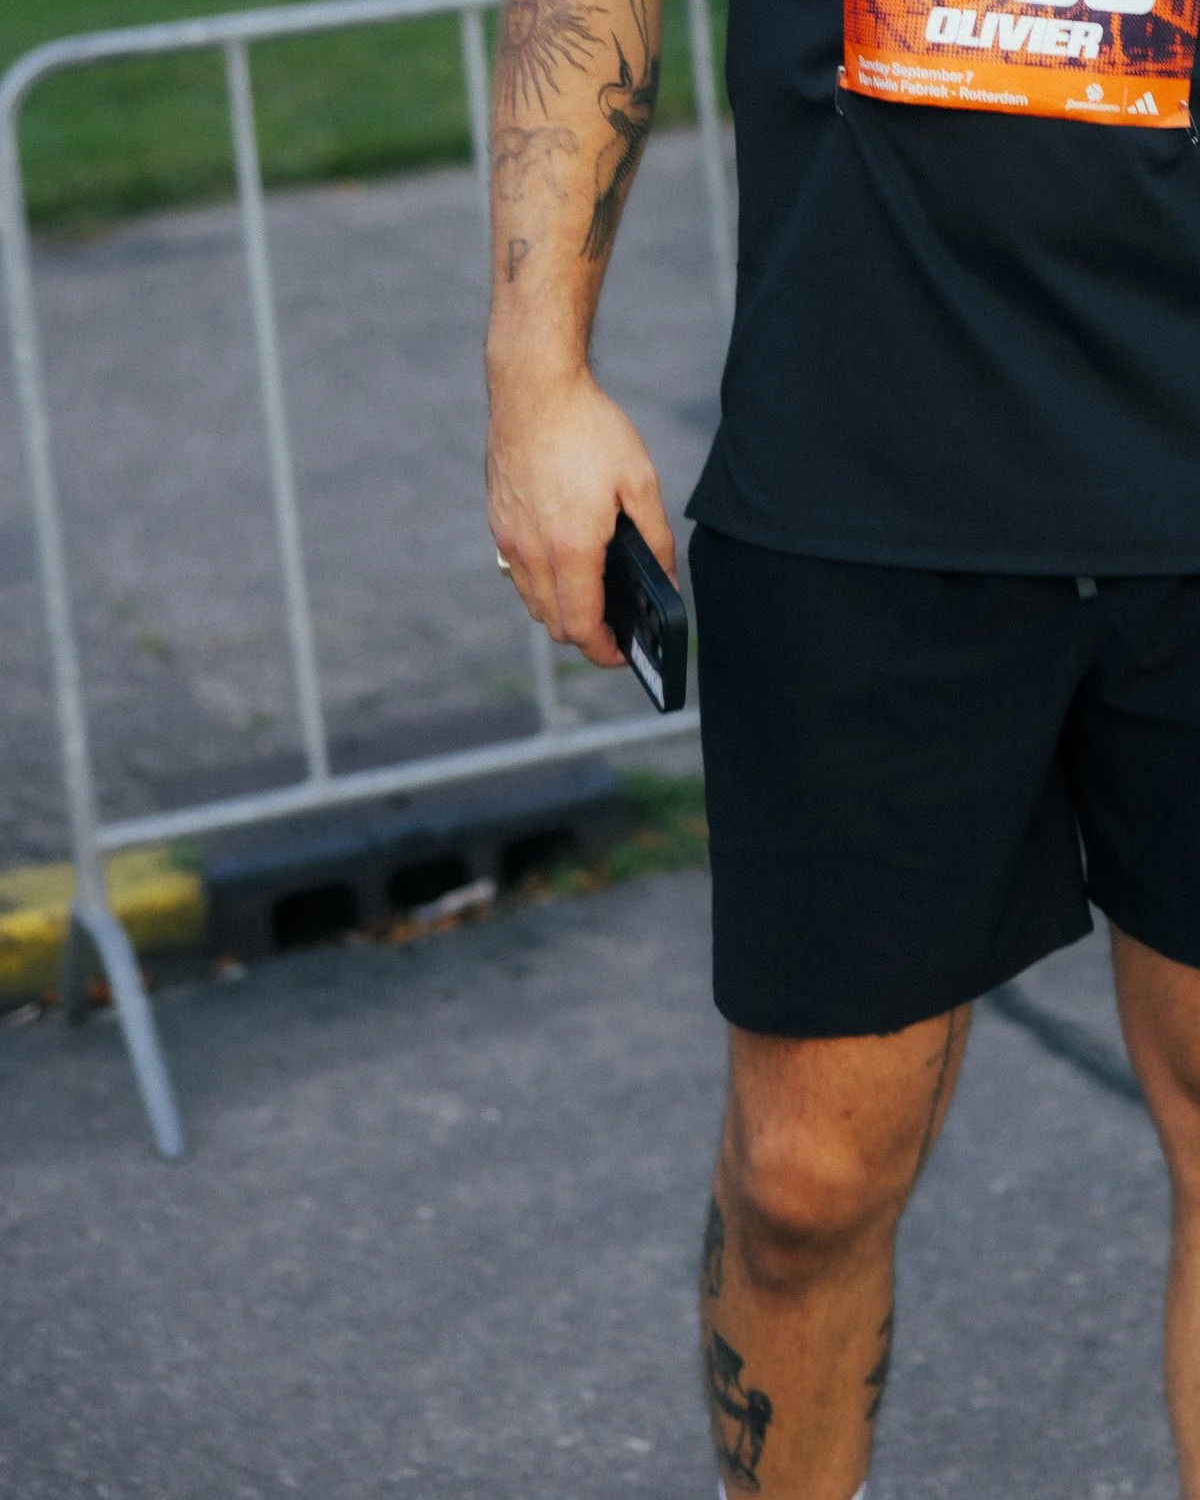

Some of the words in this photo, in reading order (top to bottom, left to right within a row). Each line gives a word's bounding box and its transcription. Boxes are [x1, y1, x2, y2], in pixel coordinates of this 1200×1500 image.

[925, 6, 1104, 59] OLIVIER
[891, 62, 963, 84] September
[900, 80, 949, 100] Fabriek
[959, 86, 1029, 107] Rotterdam
